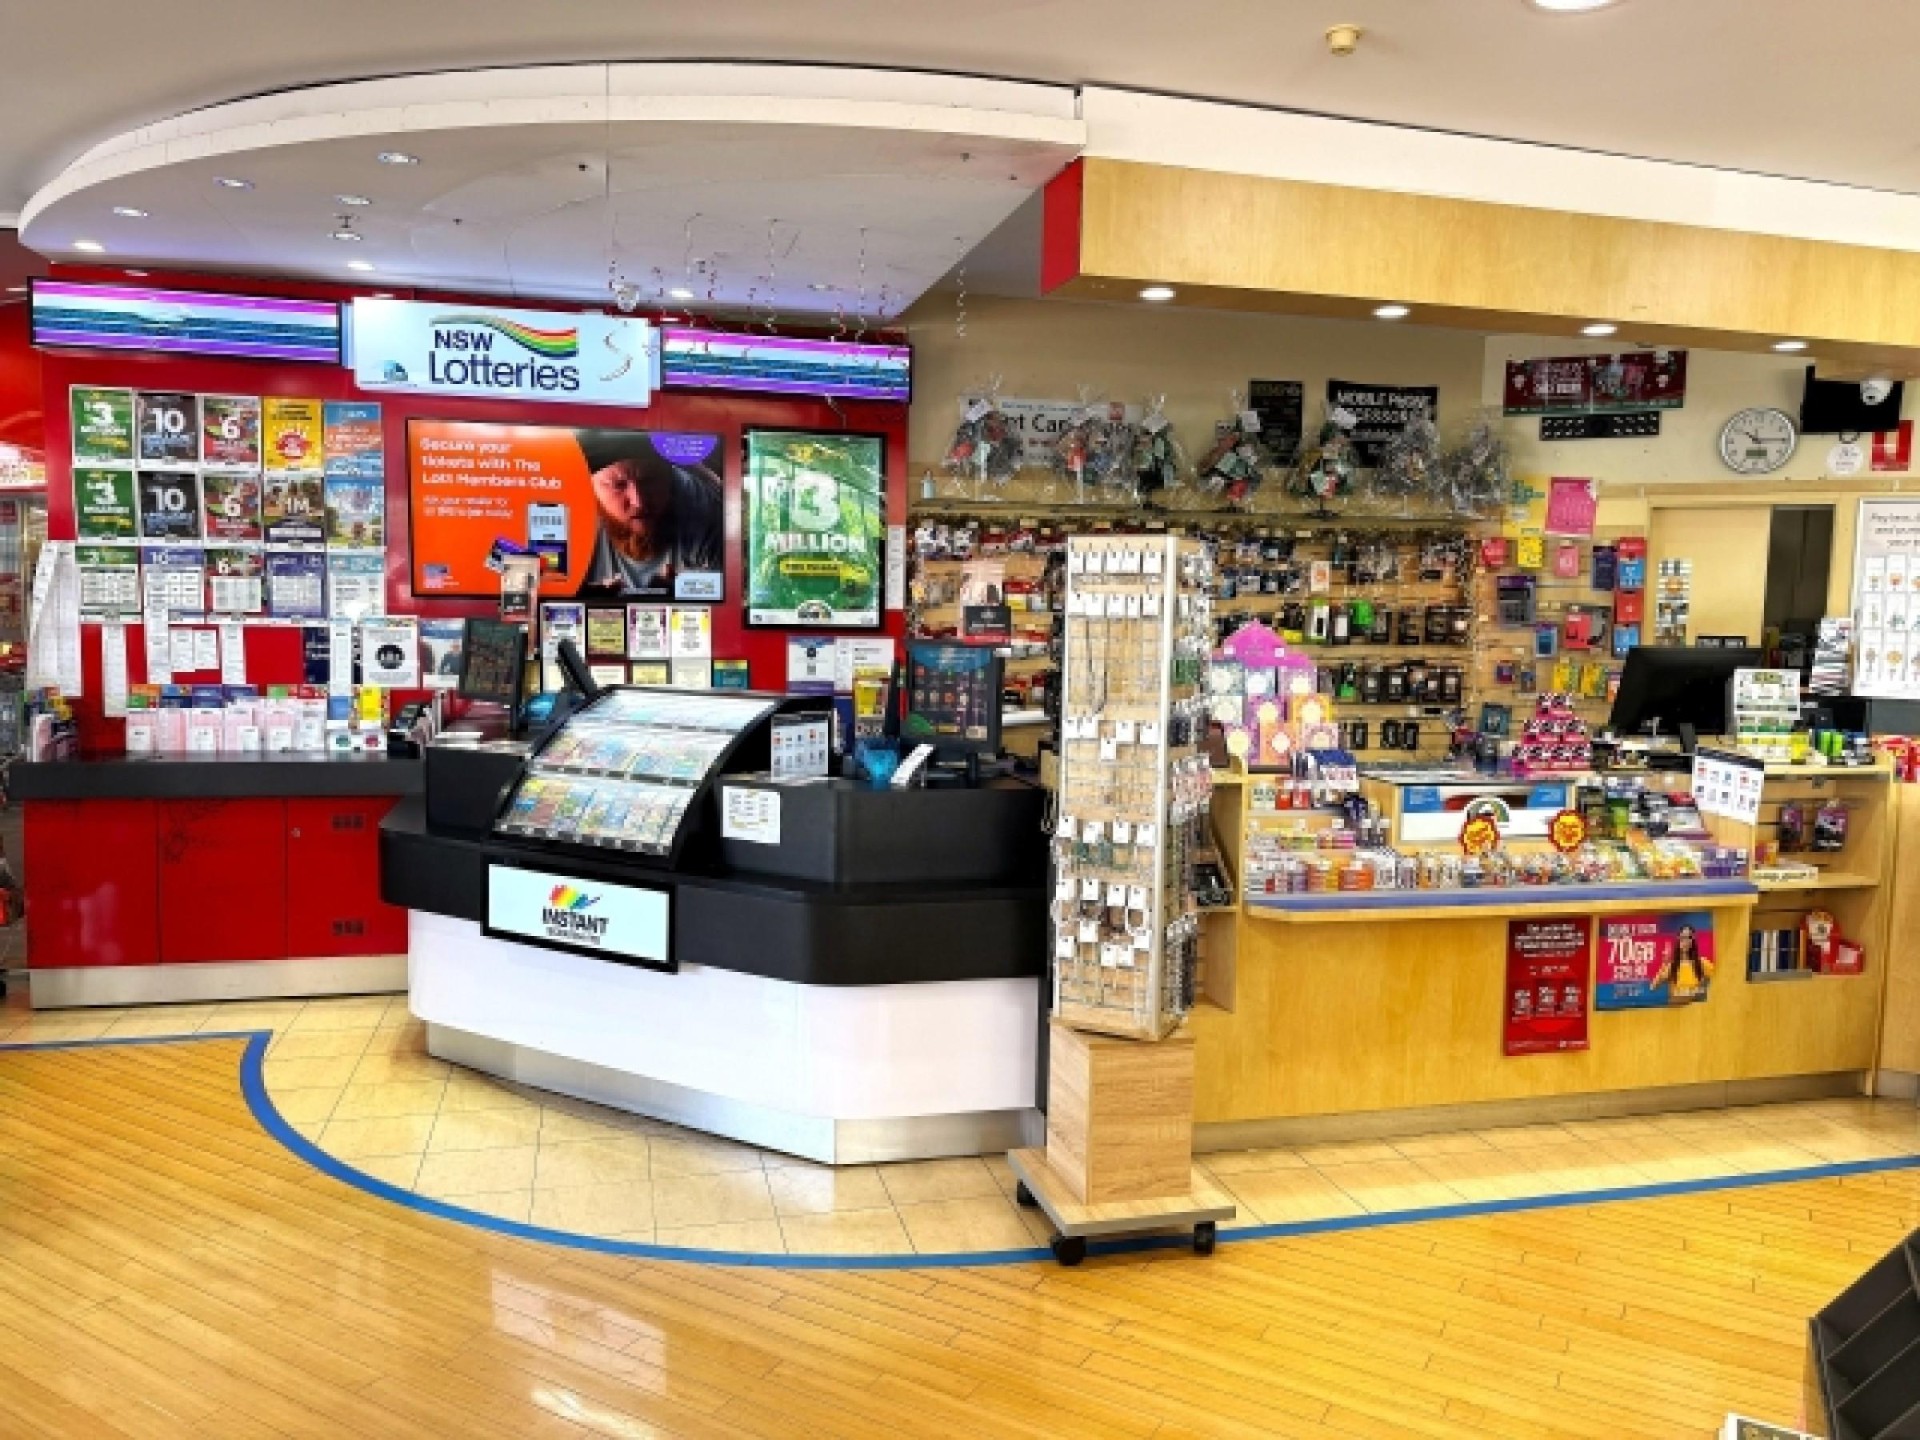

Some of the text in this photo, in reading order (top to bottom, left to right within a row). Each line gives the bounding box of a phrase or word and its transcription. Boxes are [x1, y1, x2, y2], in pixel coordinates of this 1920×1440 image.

[434, 330, 493, 351] NSW
[429, 351, 580, 391] Lotteries
[151, 408, 186, 434] 10
[221, 416, 240, 439] 6
[149, 488, 187, 512] 10
[223, 494, 241, 518] 6
[764, 531, 867, 553] MILLION
[542, 907, 609, 935] INSTANT
[1607, 938, 1656, 965] 70GB
